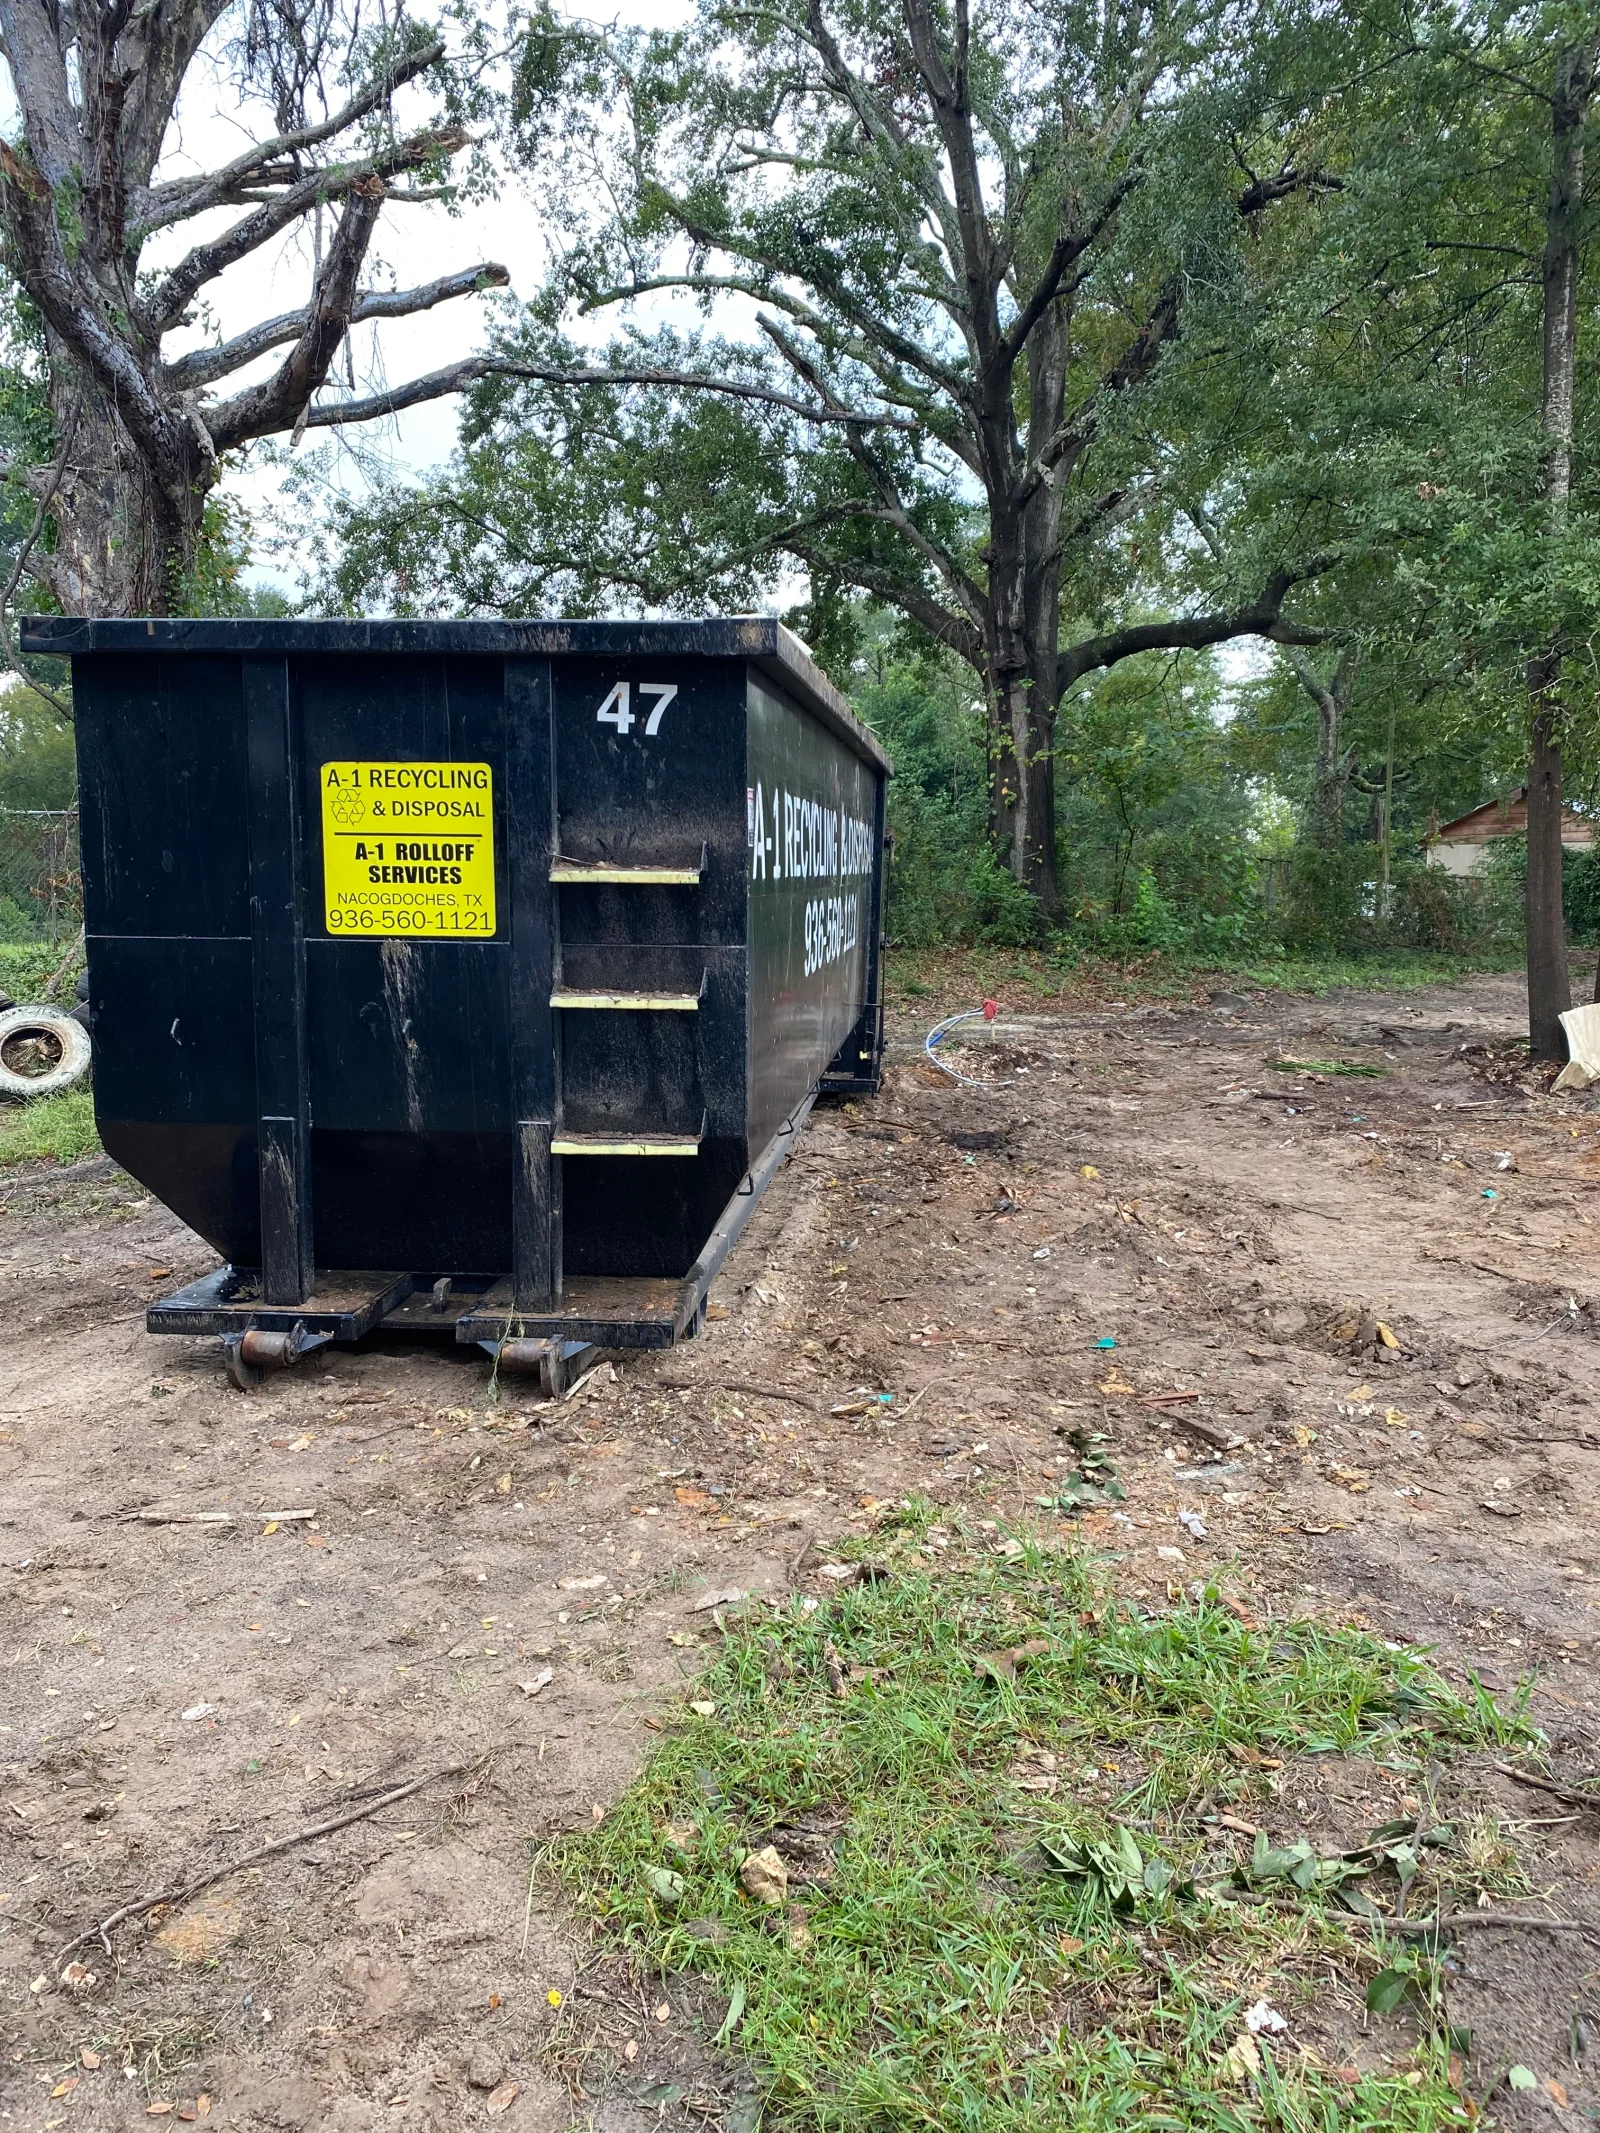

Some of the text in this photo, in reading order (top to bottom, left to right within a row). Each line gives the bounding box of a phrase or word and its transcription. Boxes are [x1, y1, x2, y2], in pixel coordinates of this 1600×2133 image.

[597, 681, 678, 736] 47
[327, 768, 488, 789] A-1 RECYCLING
[372, 800, 486, 818] & DISPOSAL
[752, 782, 781, 879] A-1
[784, 790, 838, 878] RECYCLING
[355, 842, 475, 862] A-1 ROLLOFF
[368, 865, 462, 885] SERVICES
[337, 892, 483, 908] NACOGDOCHES, TX
[329, 909, 493, 930] 936-560-1121
[804, 893, 857, 977] 936-560-1121
